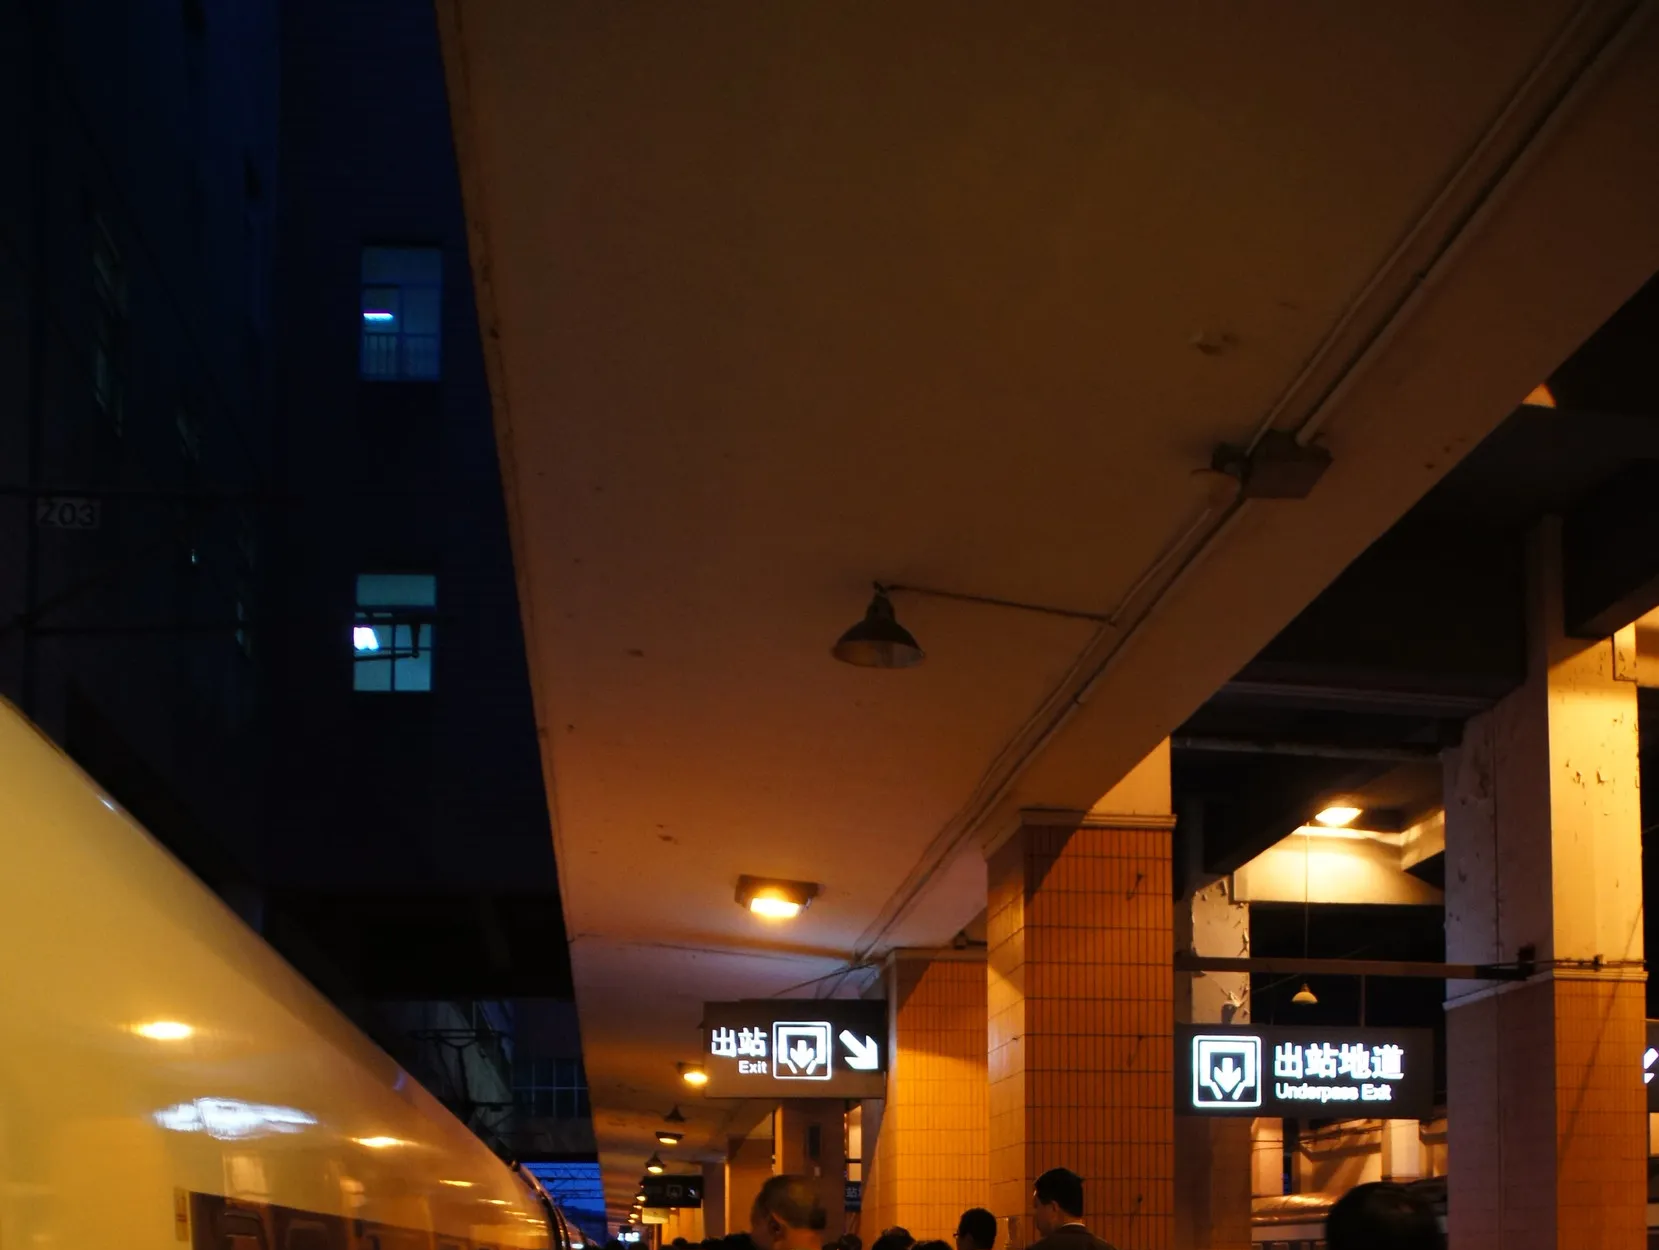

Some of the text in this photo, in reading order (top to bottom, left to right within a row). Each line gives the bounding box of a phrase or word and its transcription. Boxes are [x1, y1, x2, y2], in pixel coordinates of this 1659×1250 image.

[711, 1027, 768, 1057] 出站
[738, 1060, 767, 1074] Exit
[1274, 1042, 1404, 1079] 出站地道
[1276, 1083, 1392, 1103] Underpass Exit
